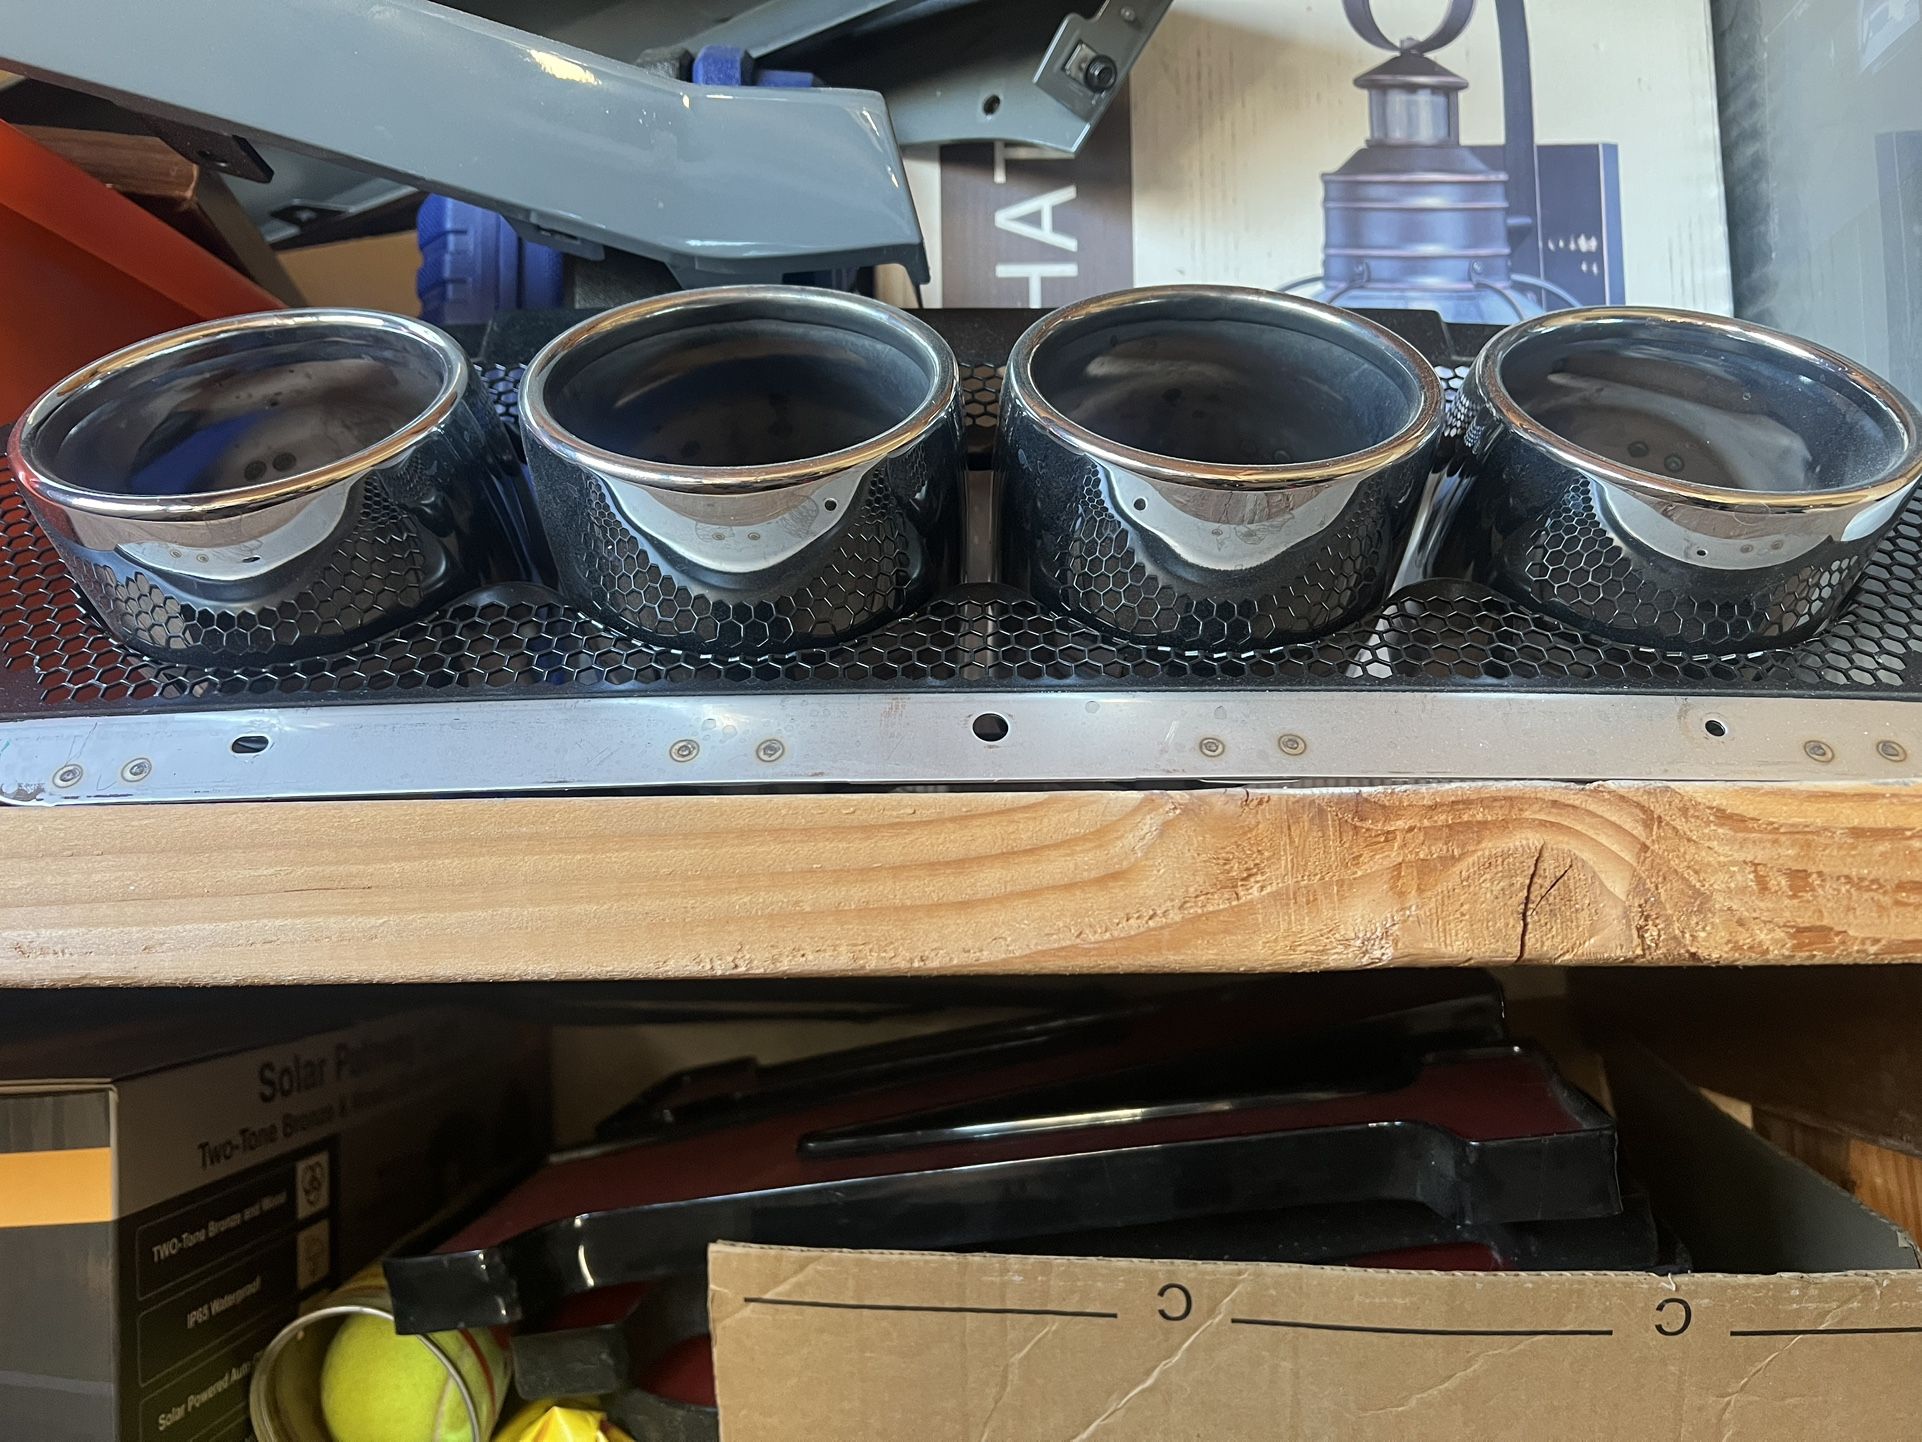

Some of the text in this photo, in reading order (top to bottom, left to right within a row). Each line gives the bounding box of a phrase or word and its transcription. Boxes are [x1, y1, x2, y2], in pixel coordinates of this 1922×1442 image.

[258, 1054, 326, 1103] Solar
[158, 1404, 186, 1431] Solar
[187, 1373, 229, 1412] Powered
